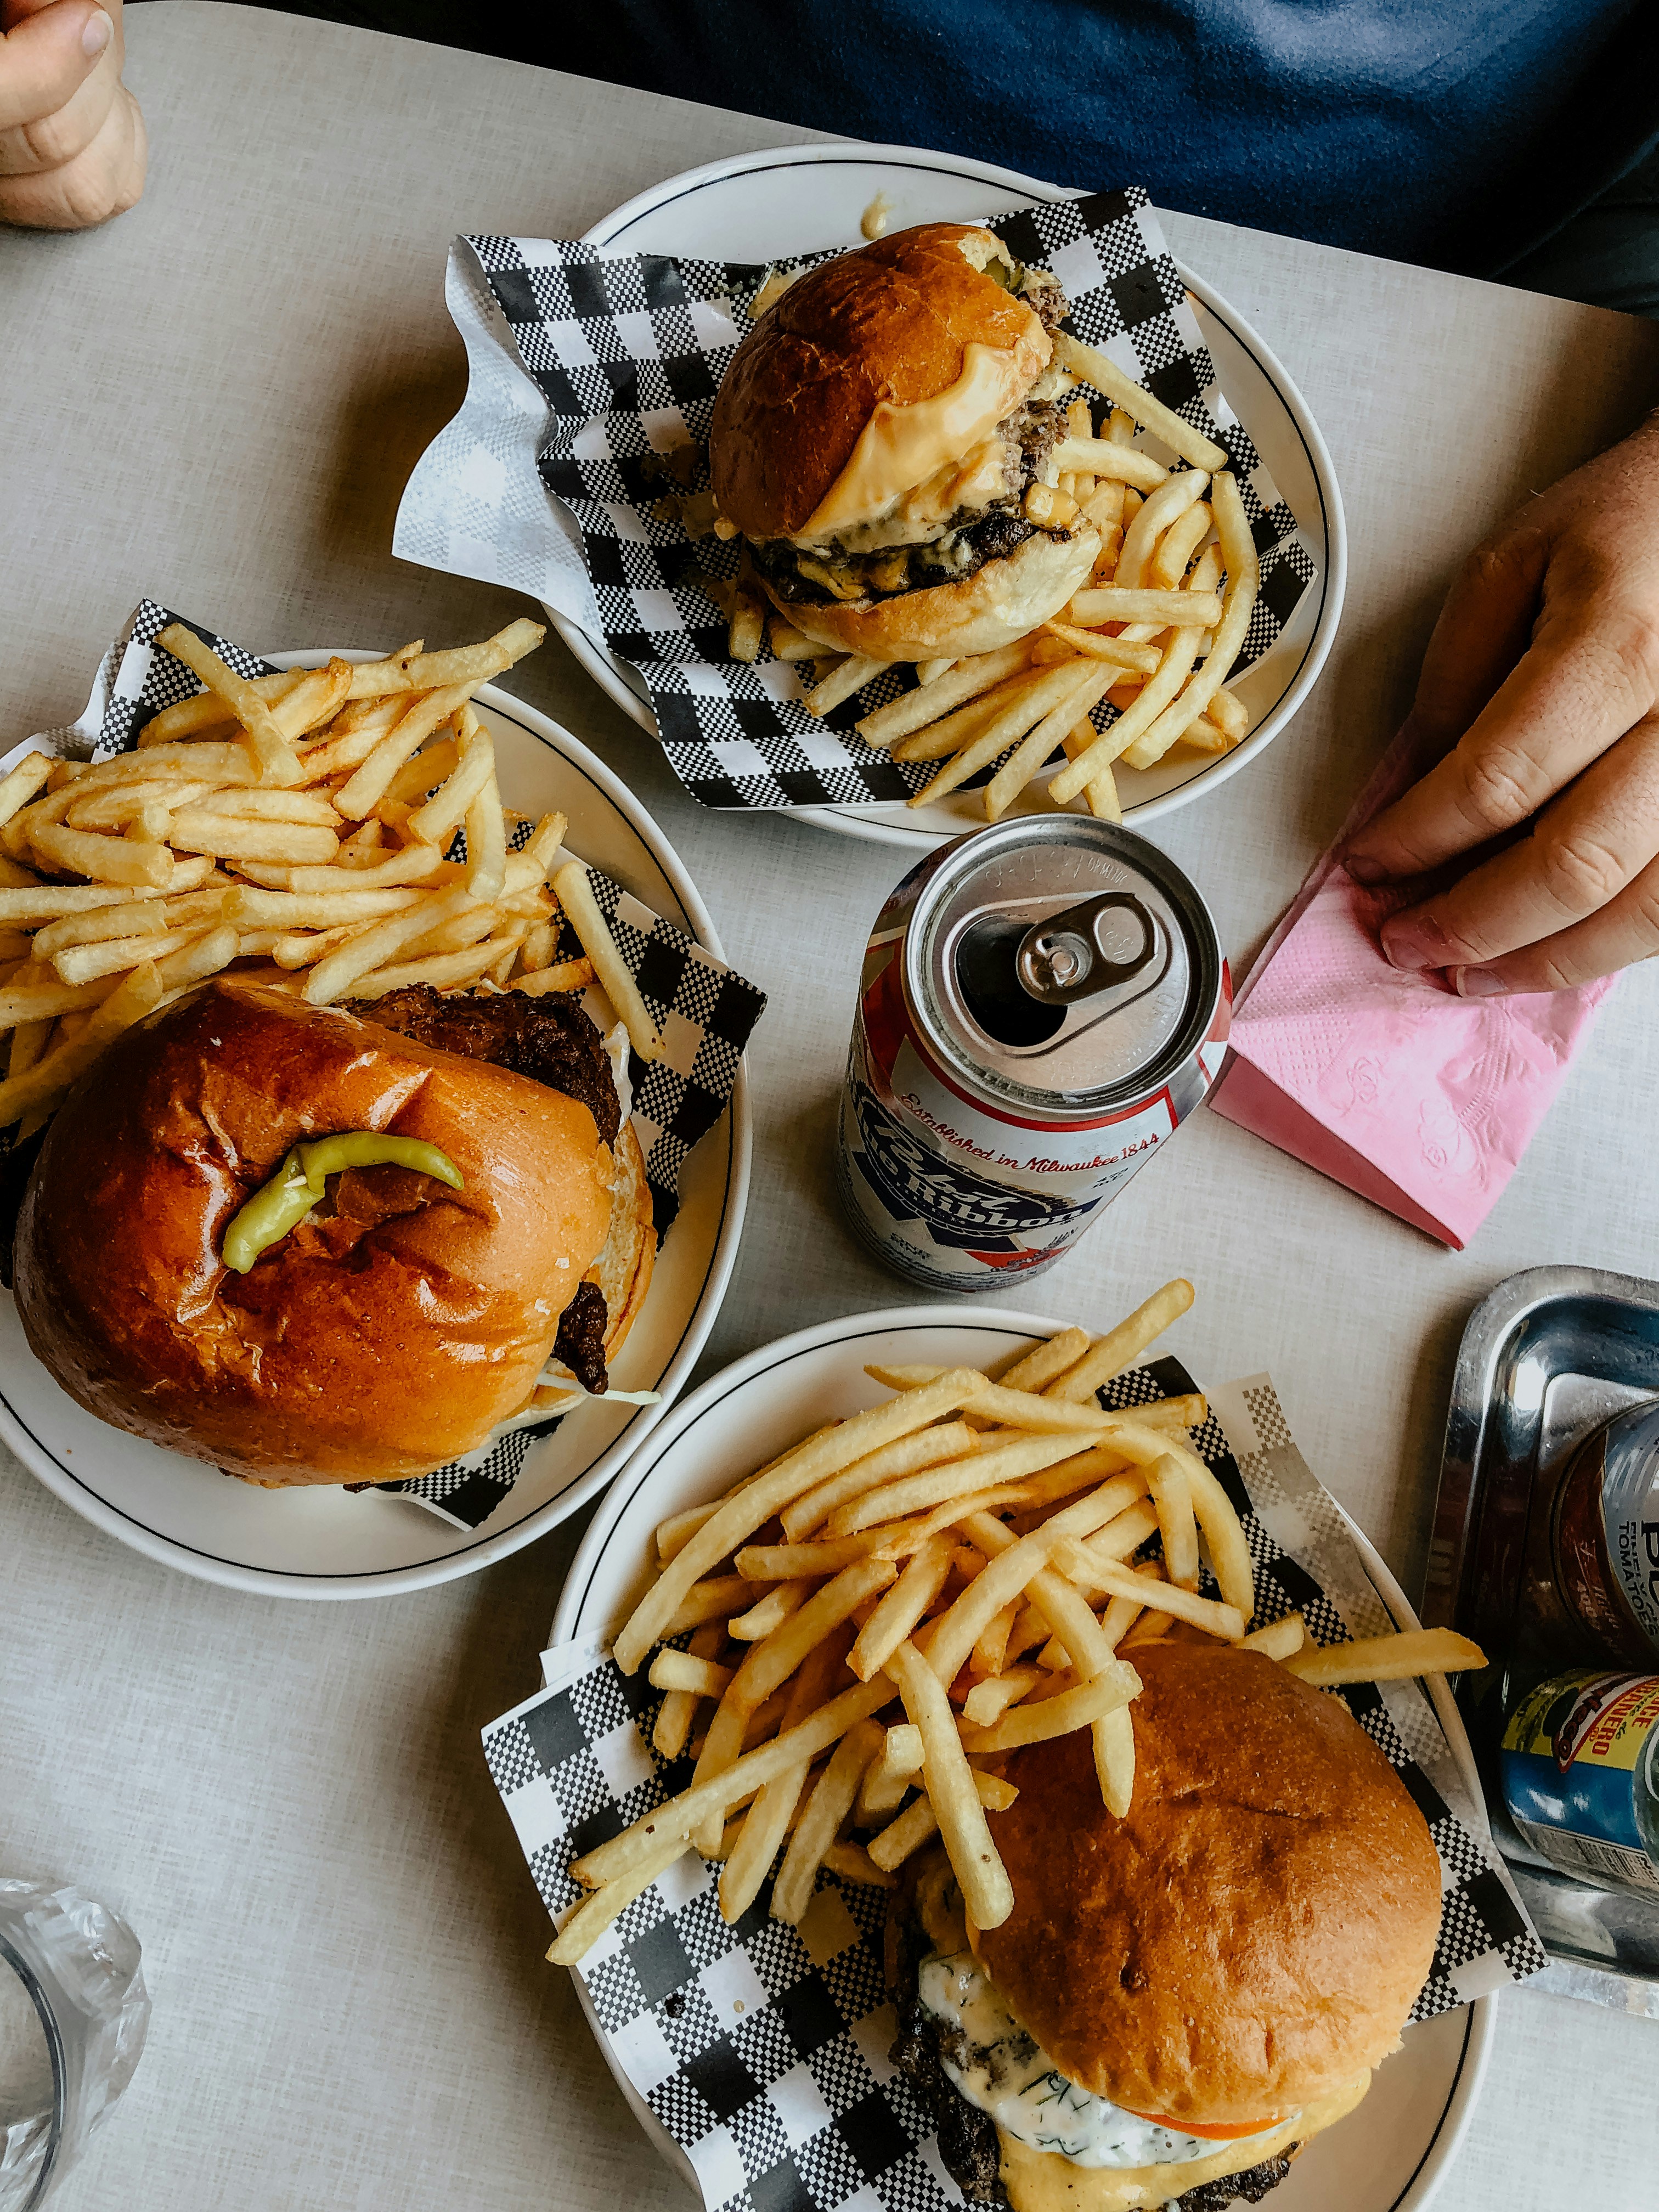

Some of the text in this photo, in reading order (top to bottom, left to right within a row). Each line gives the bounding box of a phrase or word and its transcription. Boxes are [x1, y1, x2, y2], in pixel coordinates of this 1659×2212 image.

[861, 1096, 1022, 1211] Pabst
[901, 1092, 1159, 1173] Established in Milwaukee 1844
[905, 1172, 1084, 1228] Ribbon
[1619, 1520, 1658, 1638] TOMATOES
